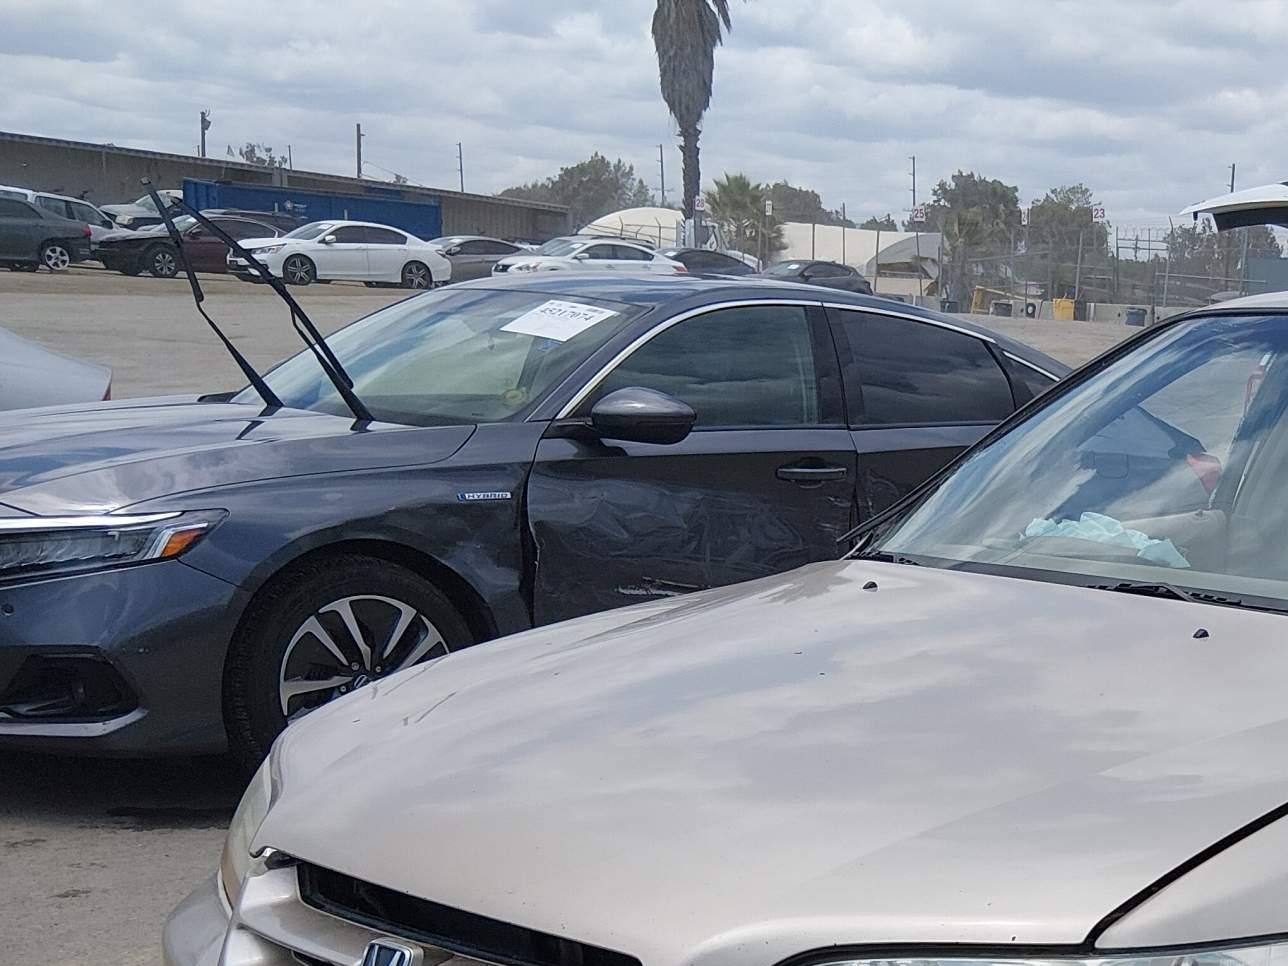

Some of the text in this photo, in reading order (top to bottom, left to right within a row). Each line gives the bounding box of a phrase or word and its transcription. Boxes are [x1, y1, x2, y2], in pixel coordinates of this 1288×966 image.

[914, 209, 925, 218] 25
[1094, 208, 1105, 219] 23
[467, 492, 508, 500] HYBRID
